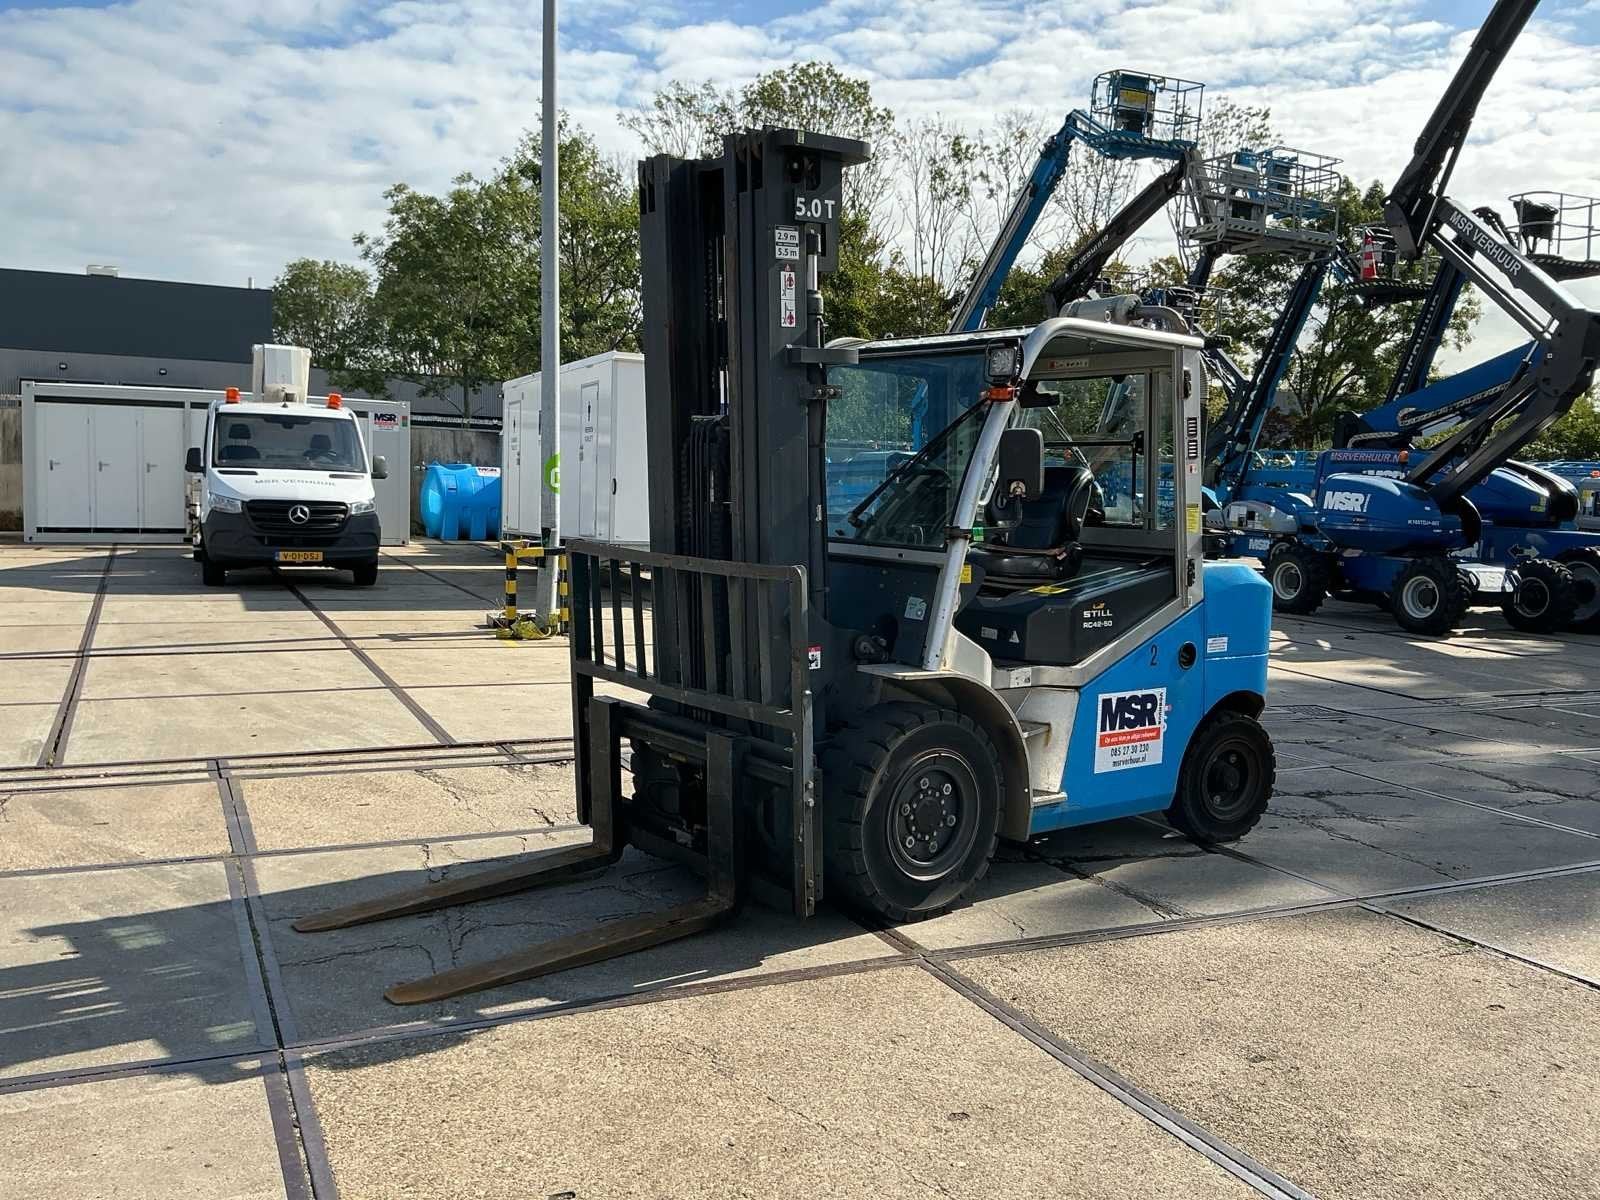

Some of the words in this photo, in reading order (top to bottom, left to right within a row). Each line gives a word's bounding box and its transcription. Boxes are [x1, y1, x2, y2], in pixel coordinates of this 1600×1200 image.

[796, 197, 821, 218] 5.0
[824, 199, 835, 219] T
[777, 232, 788, 240] 2.9
[1450, 211, 1473, 236] MSR
[1473, 228, 1521, 276] VERHUUR
[777, 248, 788, 256] 5.5
[374, 413, 396, 422] MSR
[1331, 452, 1400, 463] MSRVERHUUR.N
[1324, 491, 1365, 512] MSR
[1083, 609, 1113, 618] STILL
[1083, 620, 1113, 629] RC42-50
[1150, 644, 1158, 666] 2
[1100, 694, 1158, 732] MSR
[1111, 747, 1121, 757] 085
[1122, 746, 1130, 755] 27
[1131, 744, 1138, 754] 30
[1139, 743, 1149, 753] 230
